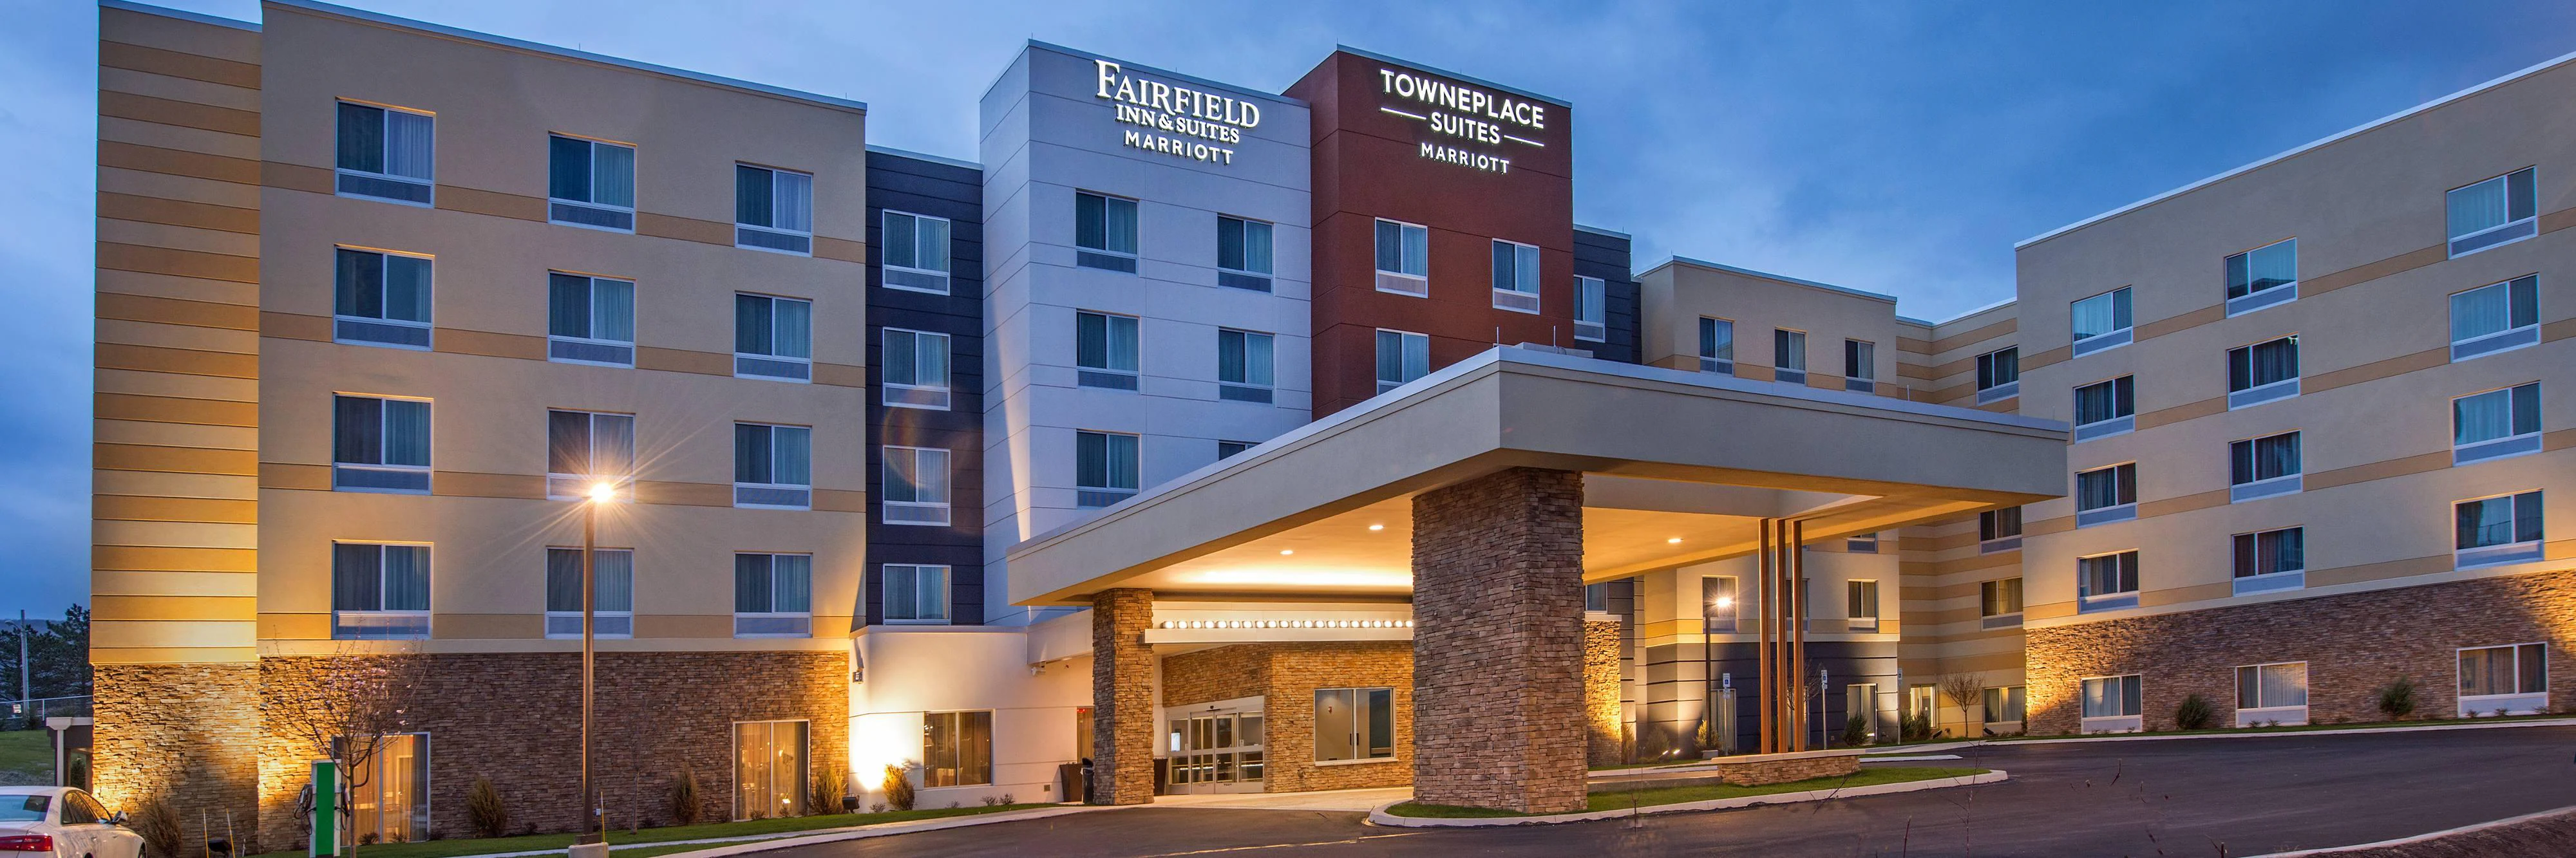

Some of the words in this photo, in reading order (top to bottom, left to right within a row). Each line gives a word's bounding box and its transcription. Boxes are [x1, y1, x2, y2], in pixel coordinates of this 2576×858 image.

[1094, 59, 1260, 128] FAIRFIELD
[1380, 68, 1544, 129] TOWNEPLACE
[1430, 111, 1501, 145] SUITES
[1124, 130, 1233, 165] MARRIOTT
[1421, 142, 1510, 174] MARRIOTT
